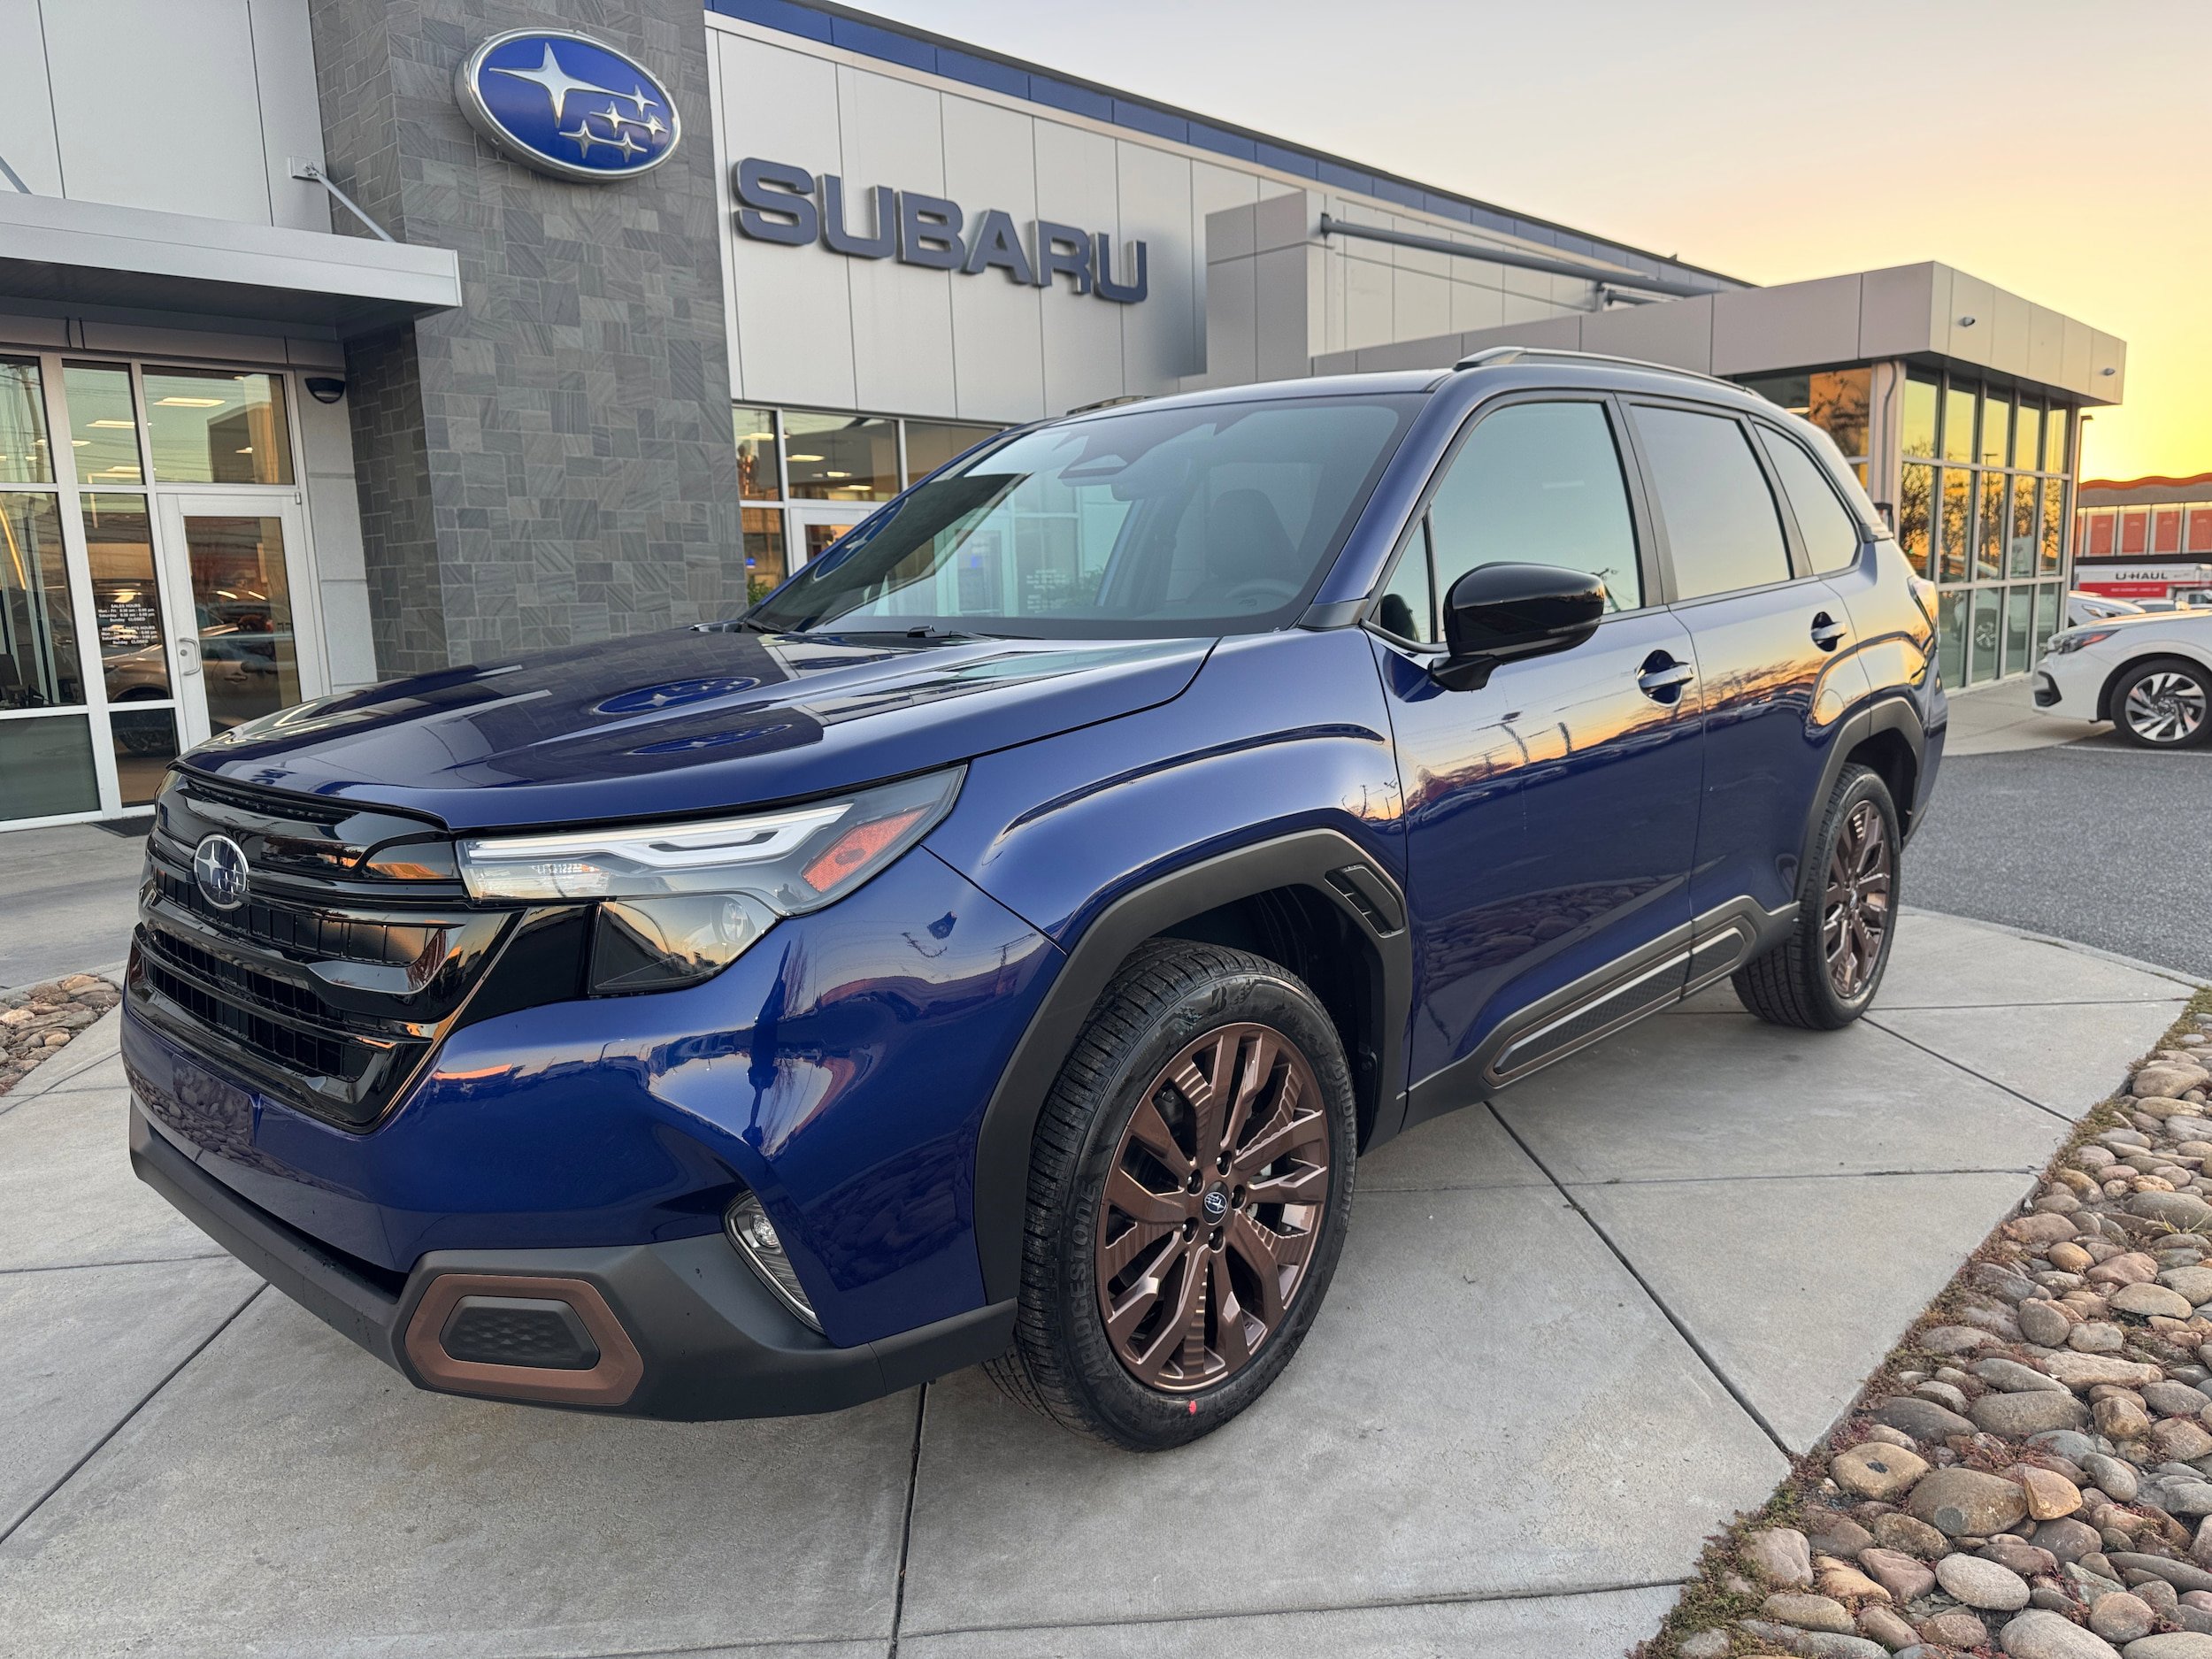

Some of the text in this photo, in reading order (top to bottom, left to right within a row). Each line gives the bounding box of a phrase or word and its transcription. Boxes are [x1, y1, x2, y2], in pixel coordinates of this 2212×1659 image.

[733, 157, 1148, 303] SUBARU
[1332, 1058, 1358, 1227] BRIDGESTONE
[1069, 1182, 1110, 1386] BRIDGESTONE
